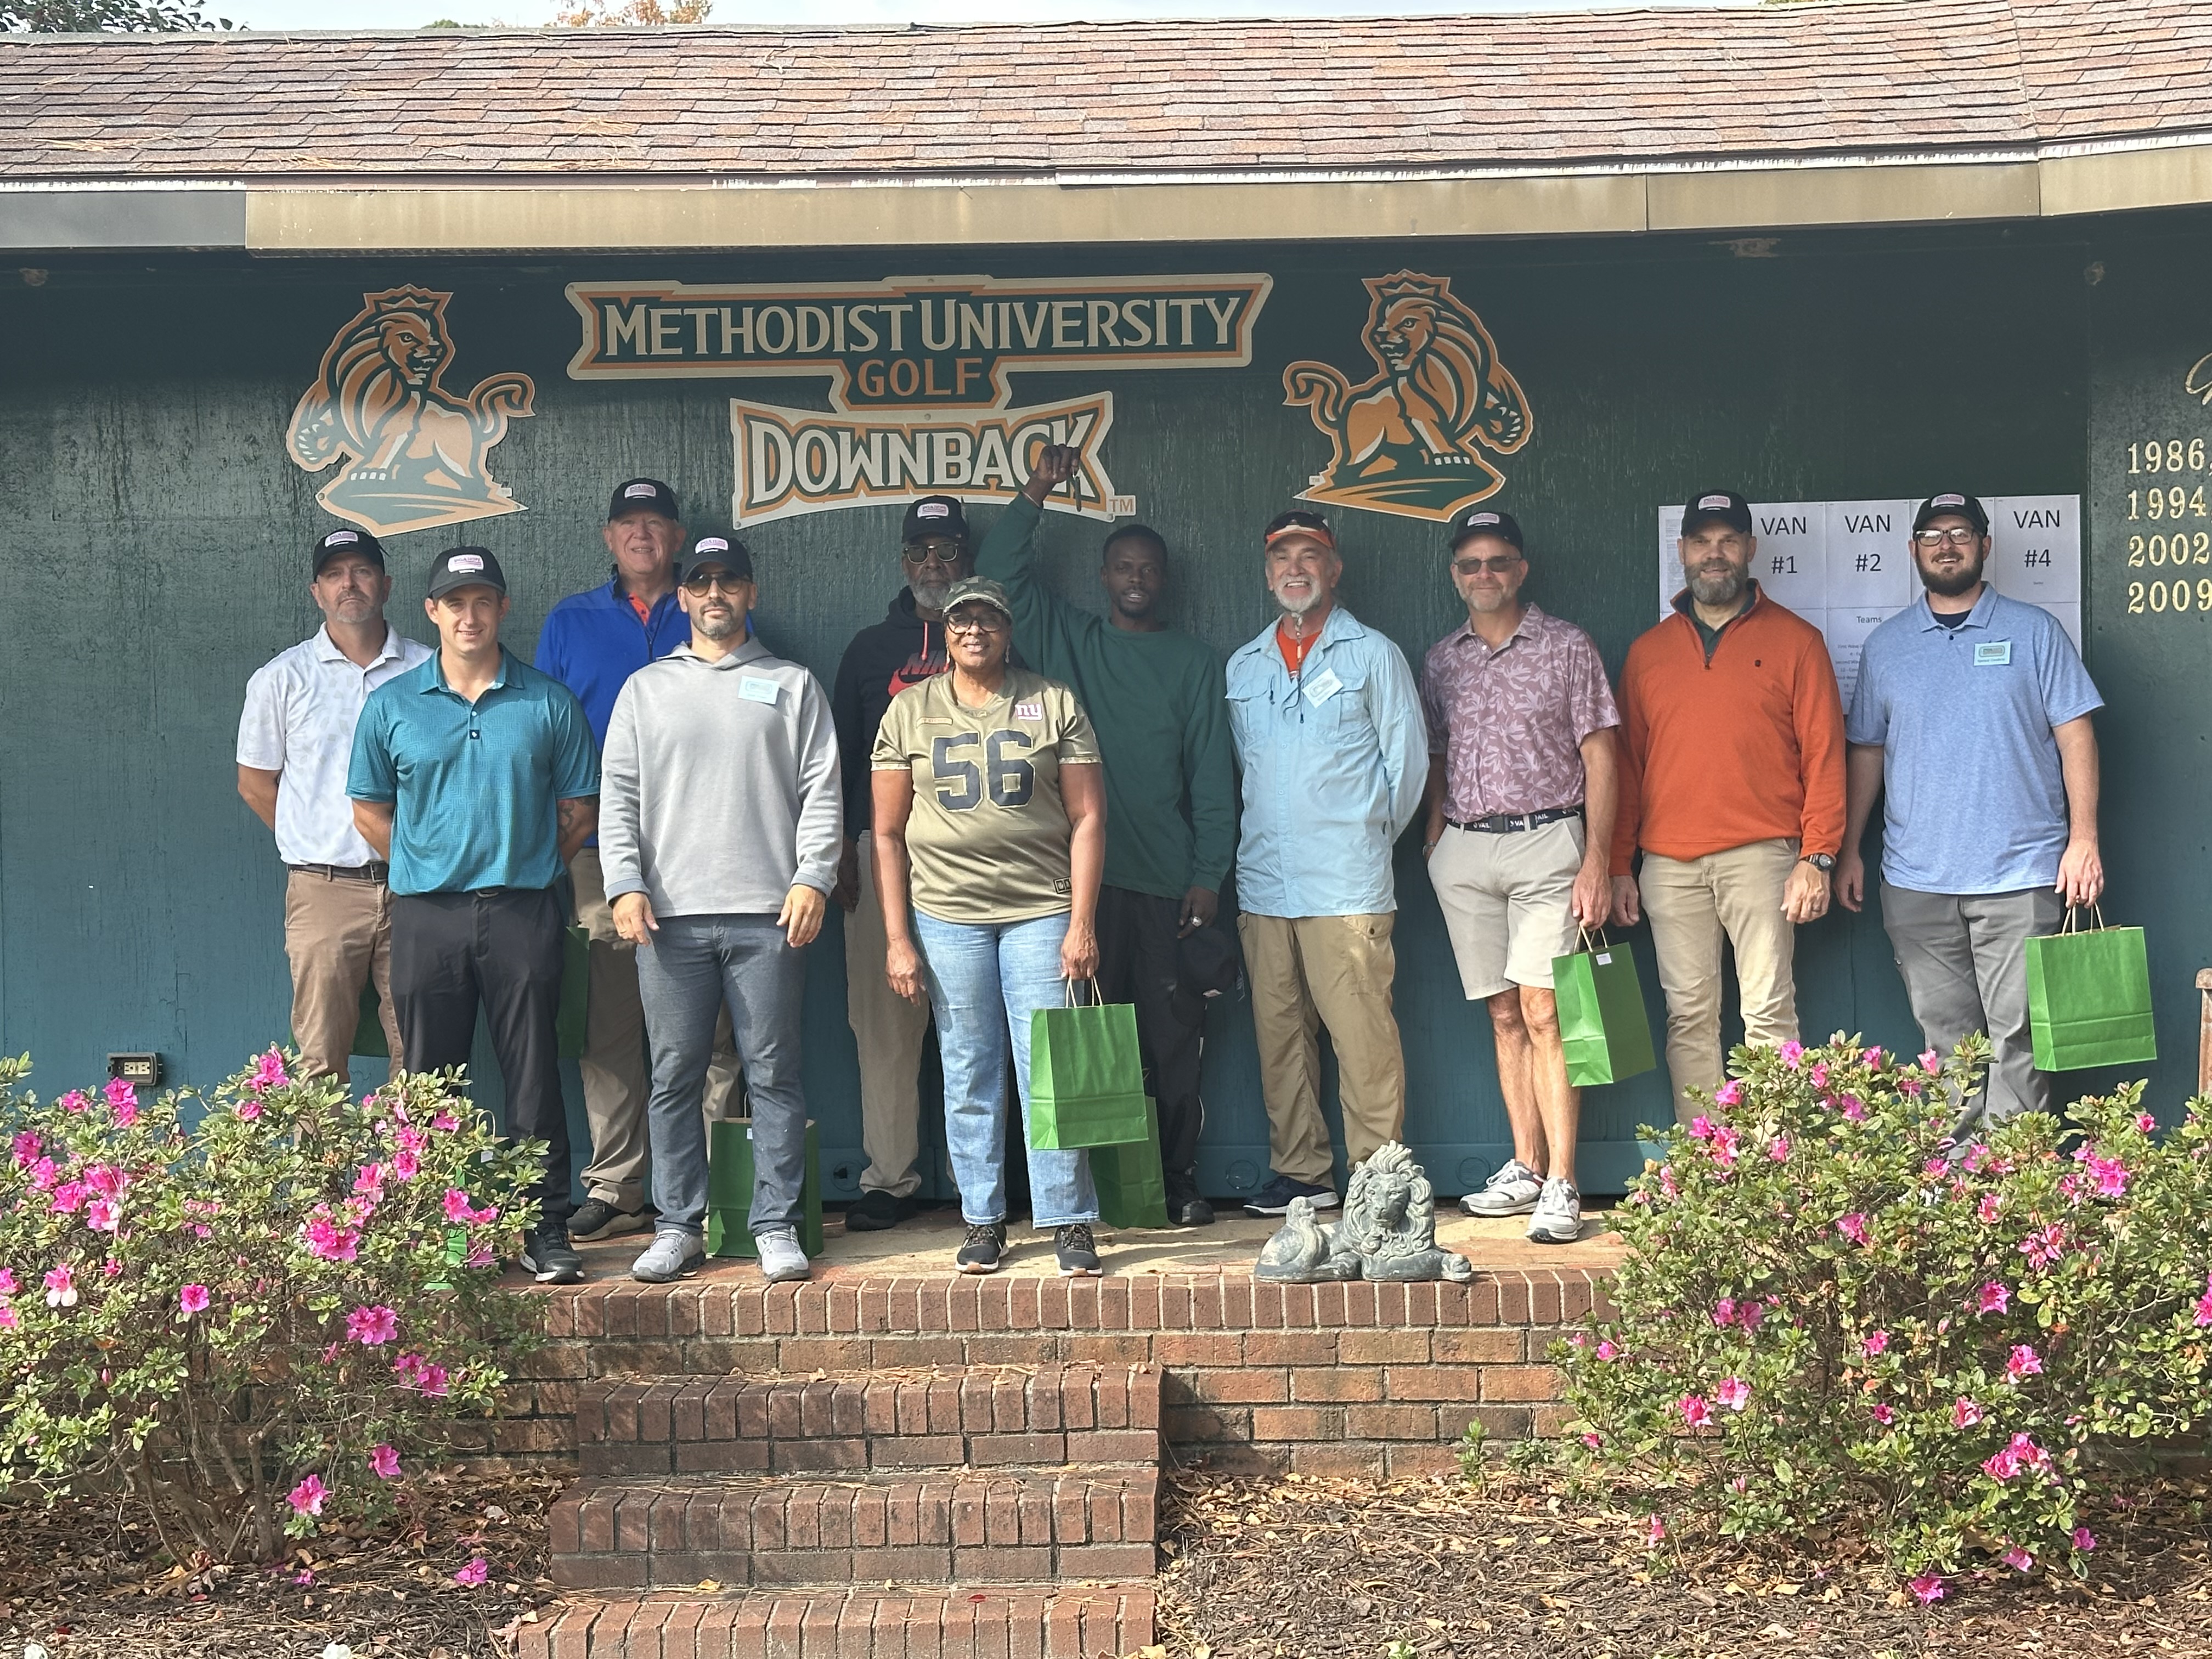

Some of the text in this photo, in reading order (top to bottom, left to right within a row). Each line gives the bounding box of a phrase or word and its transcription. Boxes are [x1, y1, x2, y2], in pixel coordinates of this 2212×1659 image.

[604, 297, 1240, 356] METHODIST UNIVERSITY
[857, 358, 982, 396] GOLF
[749, 413, 1097, 504] DOWNBACK
[1109, 498, 1133, 512] TM
[2128, 486, 2212, 521] 1994
[1760, 516, 1807, 535] VAN
[1844, 514, 1891, 533] VAN
[2013, 510, 2060, 529] VAN
[2024, 549, 2052, 567] #4
[2128, 532, 2210, 567] 2002
[1771, 556, 1798, 574] #1
[1855, 554, 1882, 572] #2
[2128, 578, 2212, 614] 2009
[1856, 616, 1882, 624] Teams
[931, 728, 1036, 812] 56
